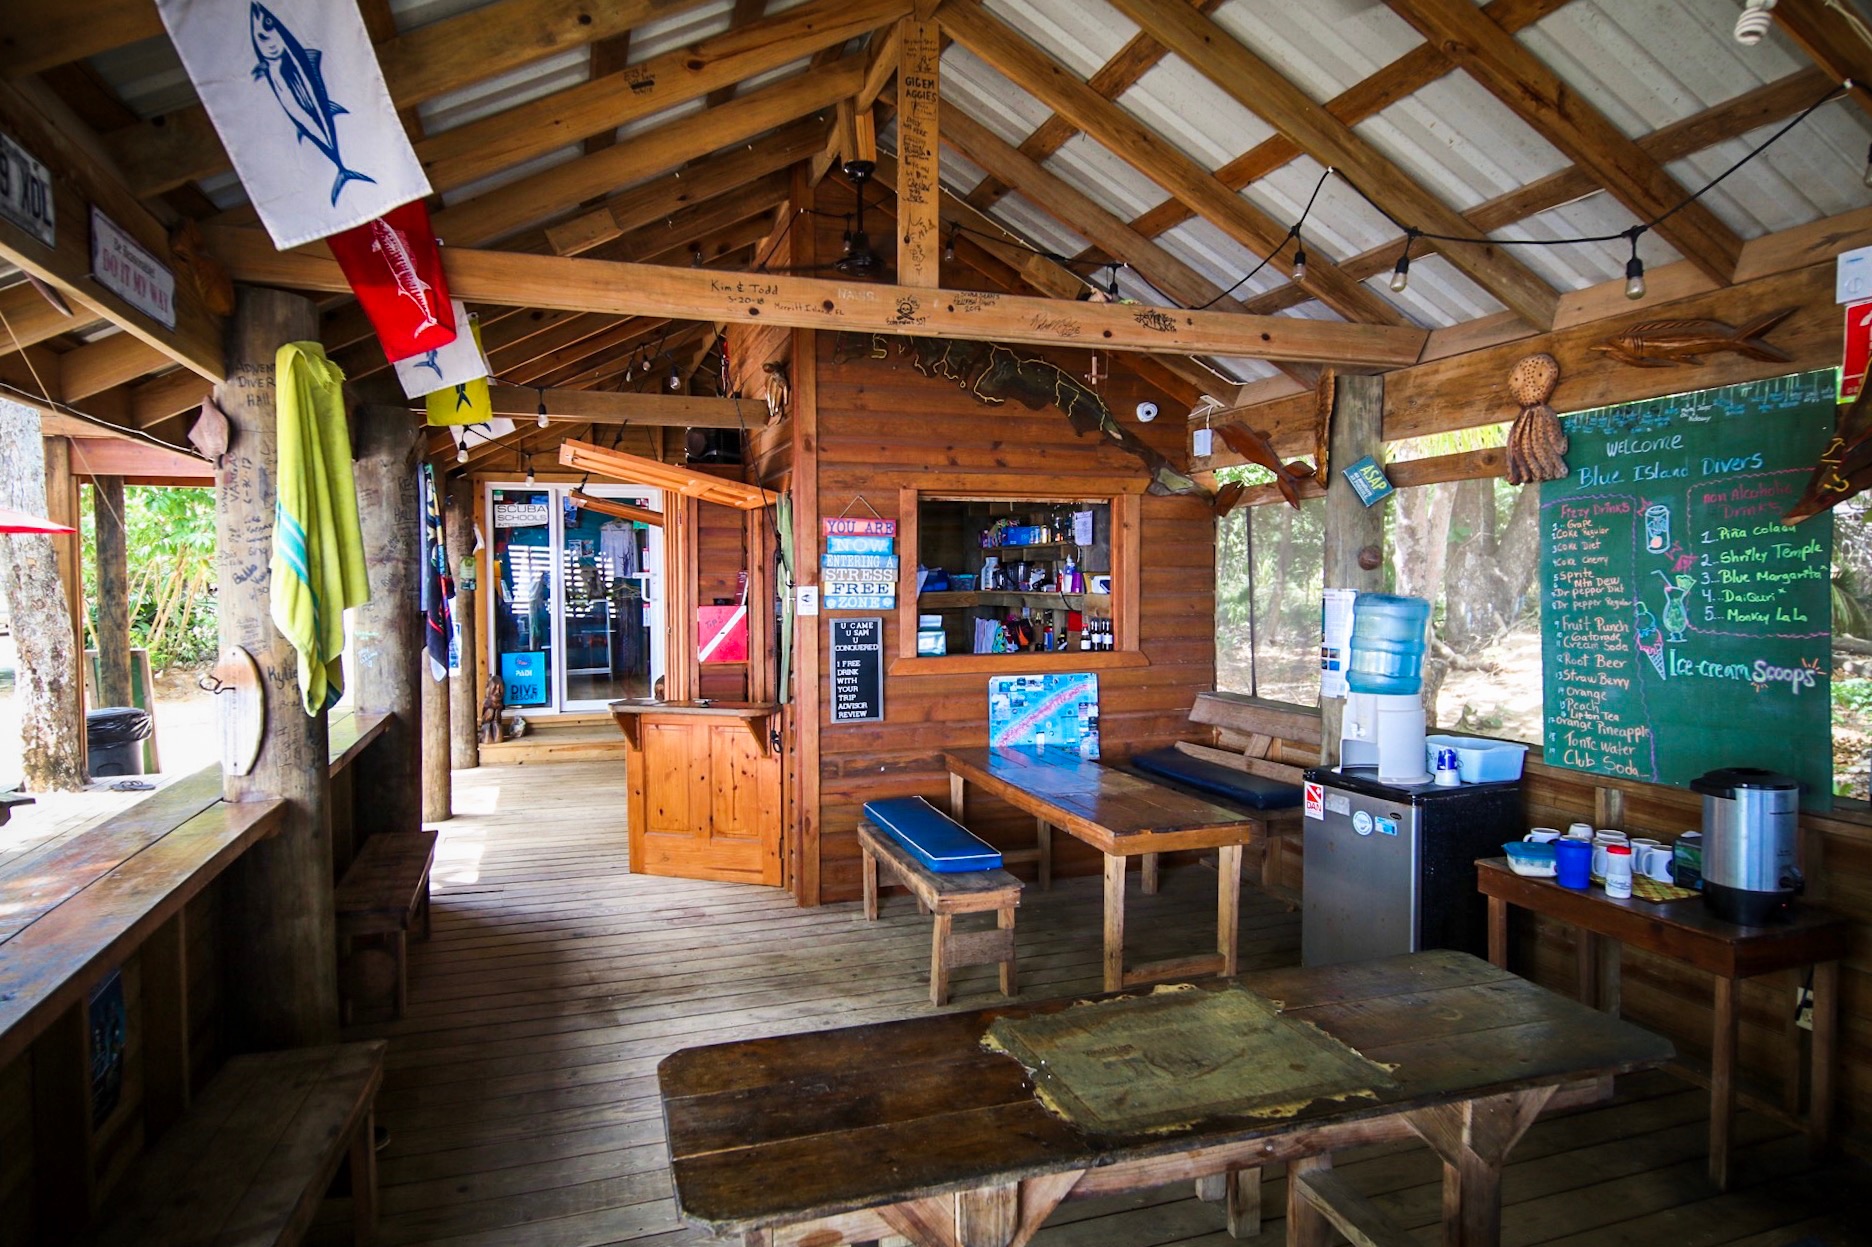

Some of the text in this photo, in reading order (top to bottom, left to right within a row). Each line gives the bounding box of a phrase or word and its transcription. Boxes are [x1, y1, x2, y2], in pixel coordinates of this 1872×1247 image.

[711, 280, 732, 292] Kim
[749, 284, 779, 295] Todd
[1360, 464, 1388, 491] ASAP
[1576, 465, 1625, 490] Blue
[1702, 453, 1764, 476] Divers
[497, 505, 546, 513] SCUBA
[827, 520, 894, 535] YOU ARE
[834, 539, 888, 552] NOW
[1770, 538, 1823, 562] Temple
[826, 554, 895, 568] ENTERING A
[825, 568, 894, 581] STRESS
[1717, 569, 1751, 585] Blue
[832, 583, 890, 595] FREE
[837, 596, 881, 608] ZONE
[1562, 614, 1592, 631] Fruit
[1594, 616, 1630, 633] Punch
[834, 643, 880, 652] CONQUERED
[1563, 636, 1600, 650] Cream
[1603, 639, 1630, 652] Soda
[842, 660, 861, 668] FREE
[1594, 653, 1628, 669] Beer
[515, 669, 533, 677] PADI
[837, 668, 859, 676] DRINK
[1752, 659, 1817, 695] Scoops
[837, 677, 858, 685] WITH
[511, 684, 538, 695] DIVE
[1566, 686, 1608, 705] Orange
[838, 694, 857, 702] TRIP
[837, 702, 868, 710] ADVISOR
[1565, 697, 1600, 714] Peach
[838, 711, 868, 719] REVIEW
[1601, 711, 1620, 722] Tea
[1556, 716, 1594, 732] Orange
[1564, 730, 1598, 751] Tonic
[1563, 749, 1596, 768] Club
[1306, 801, 1322, 812] DAN
